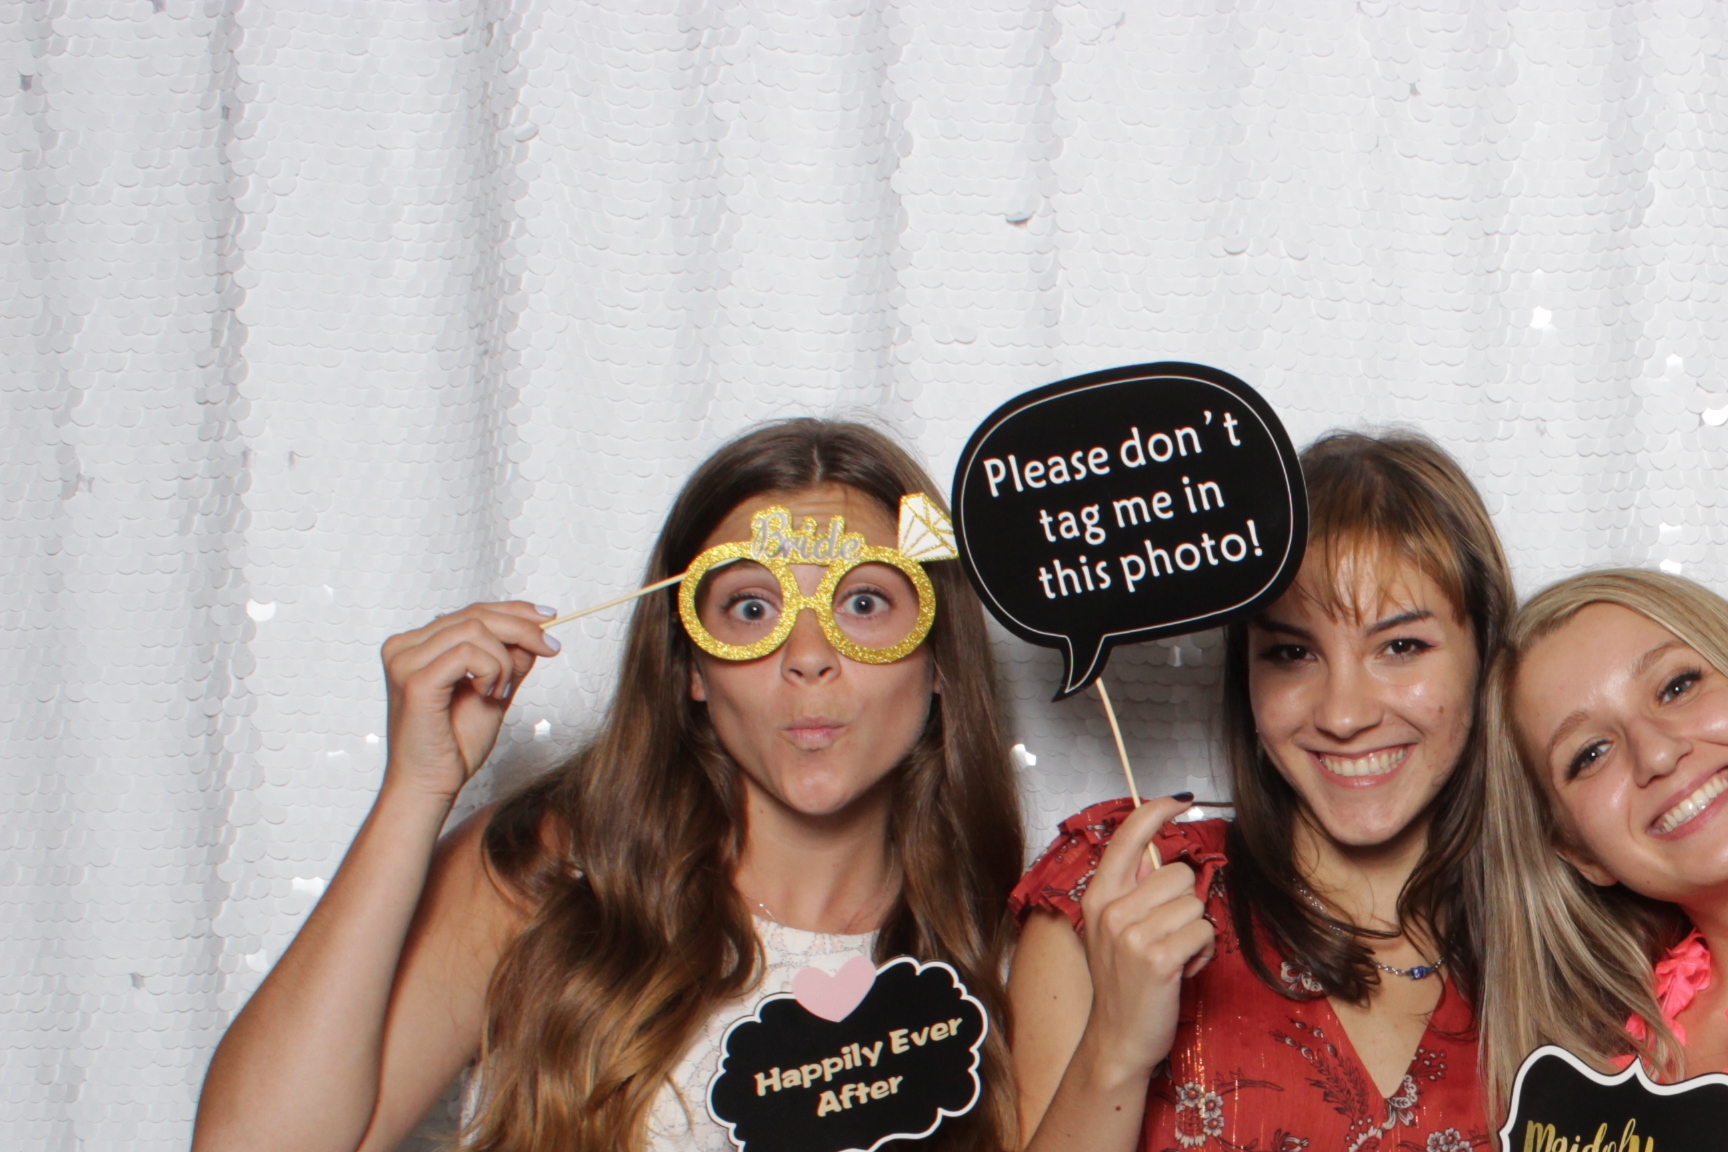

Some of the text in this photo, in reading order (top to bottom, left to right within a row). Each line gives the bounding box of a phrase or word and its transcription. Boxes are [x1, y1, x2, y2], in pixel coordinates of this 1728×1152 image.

[983, 446, 1111, 498] Please
[751, 511, 865, 562] Bride
[1038, 475, 1225, 546] tag me in
[1038, 519, 1264, 600] this photo!
[753, 1017, 963, 1097] Happily Ever
[816, 1075, 904, 1118] After
